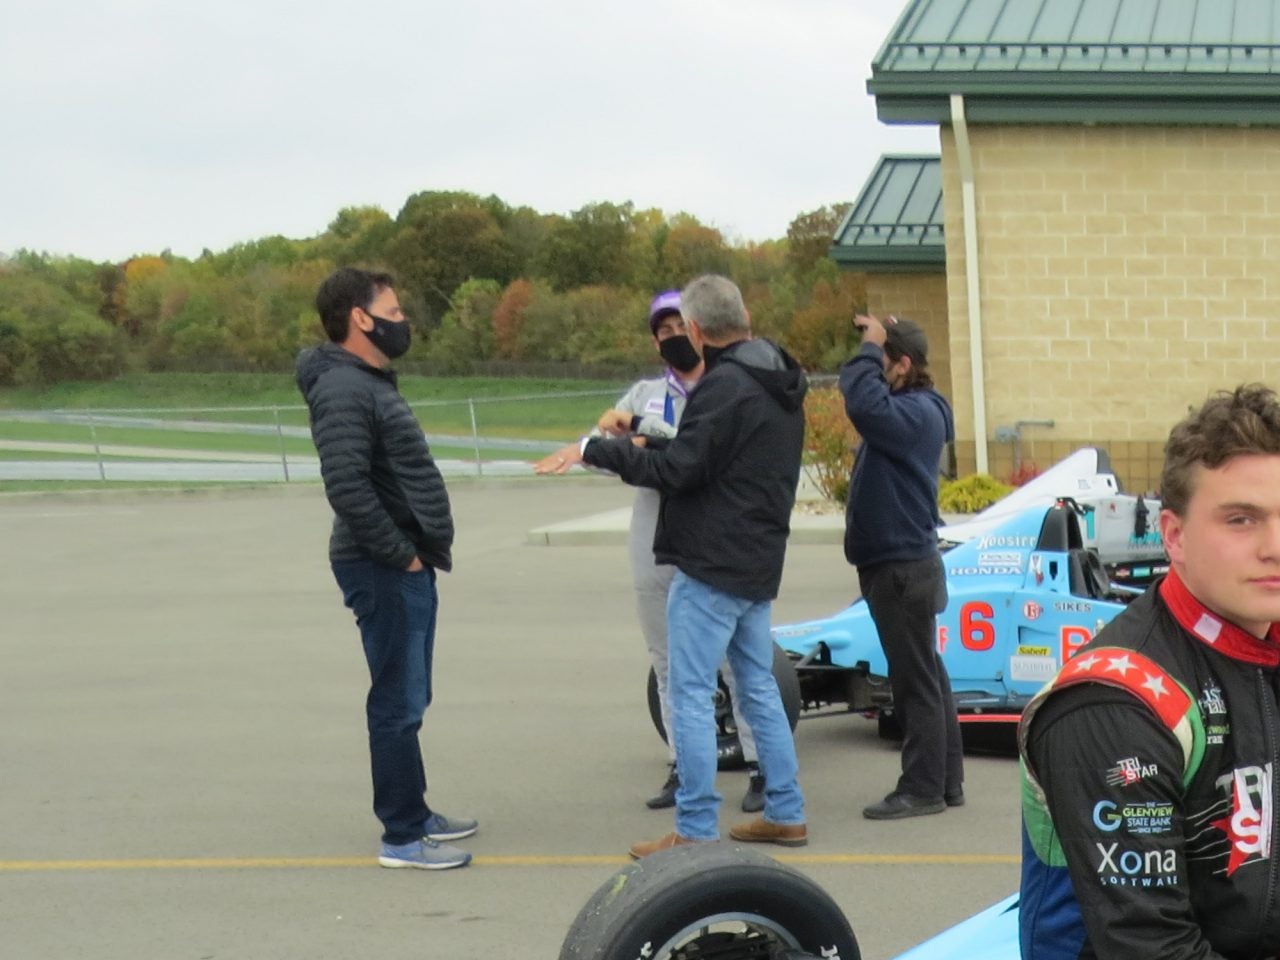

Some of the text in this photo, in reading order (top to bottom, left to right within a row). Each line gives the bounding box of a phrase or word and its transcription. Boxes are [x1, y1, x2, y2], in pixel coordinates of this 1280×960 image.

[950, 567, 1022, 576] HONDA
[1055, 602, 1091, 612] SIKES
[959, 601, 995, 651] 6
[1116, 757, 1140, 771] TRI
[1126, 764, 1158, 781] STAR
[1122, 806, 1174, 817] GLENVIEW
[1127, 817, 1171, 827] STATE BANK
[1096, 842, 1177, 874] Xona
[1100, 876, 1178, 886] SOFTWARE
